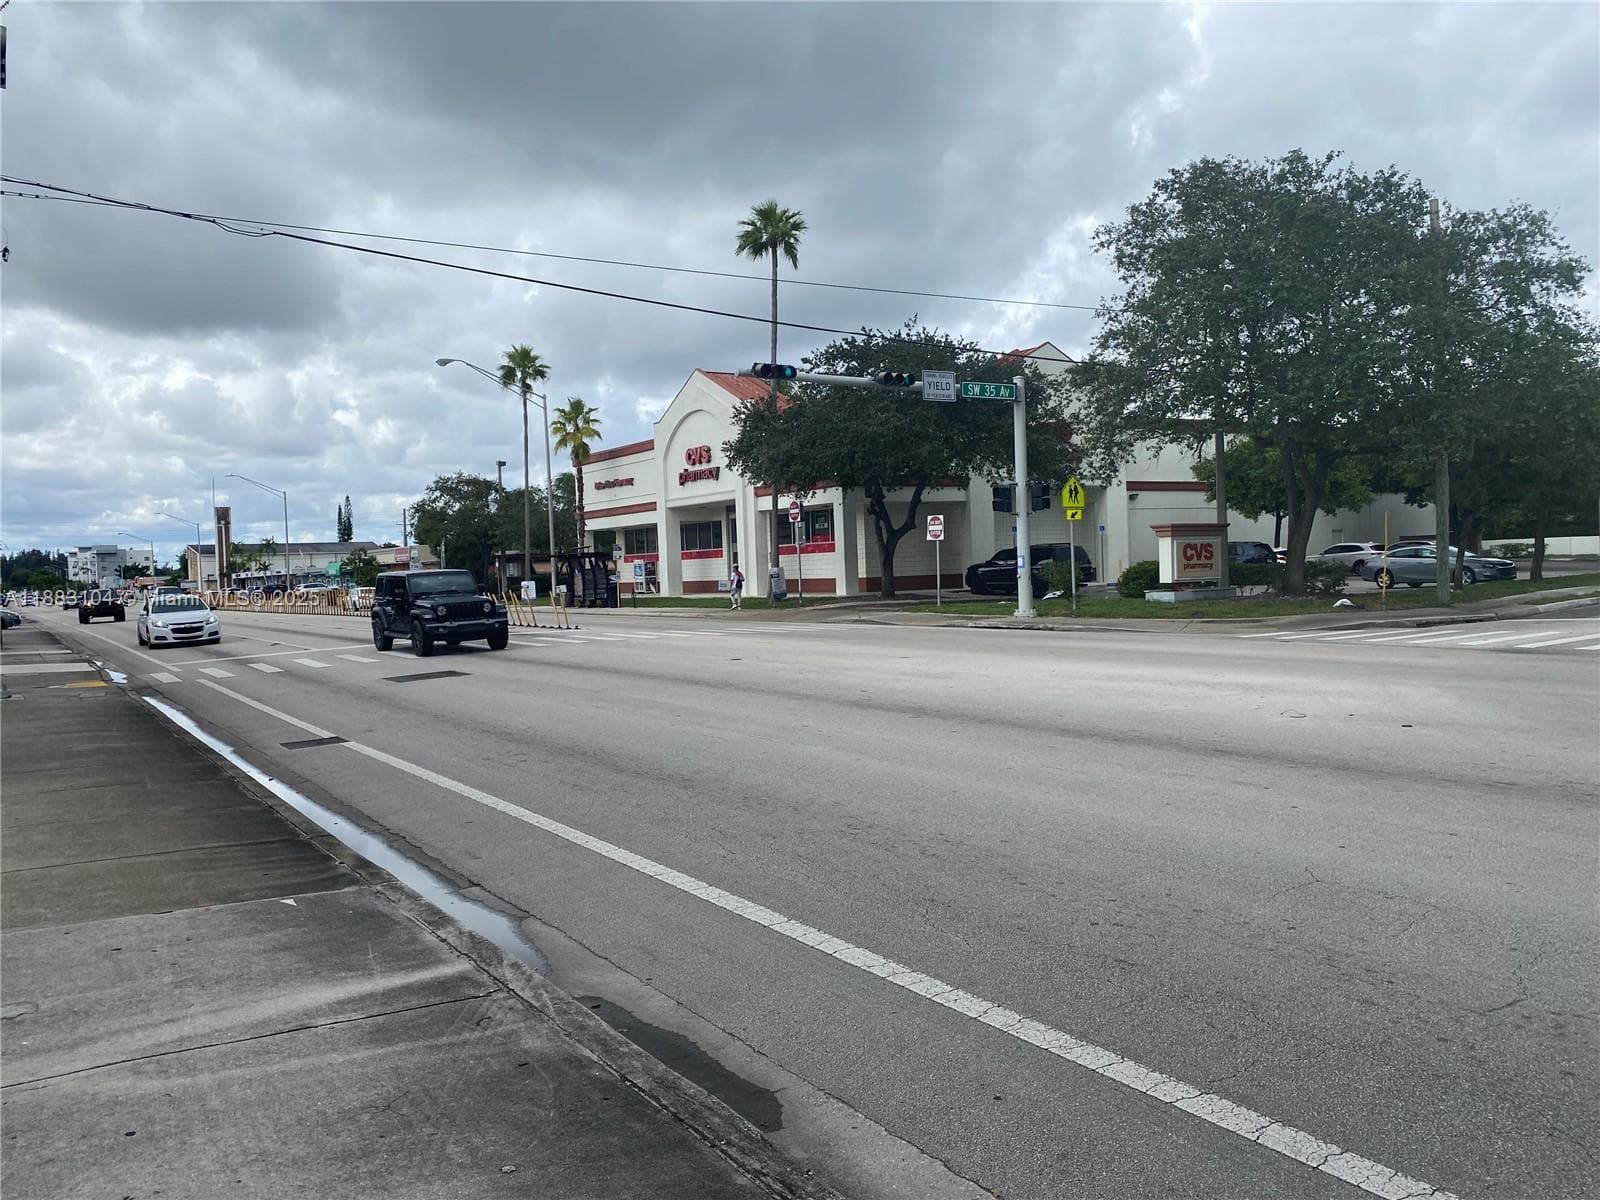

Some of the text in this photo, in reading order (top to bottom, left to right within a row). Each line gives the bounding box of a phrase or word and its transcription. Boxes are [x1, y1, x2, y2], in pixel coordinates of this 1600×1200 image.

[927, 381, 951, 391] YIELD
[968, 384, 1010, 397] SW 35 Av
[685, 445, 712, 465] CVS
[679, 466, 720, 486] pharmacy
[1183, 543, 1214, 561] CVS
[1183, 562, 1214, 571] pharmacy
